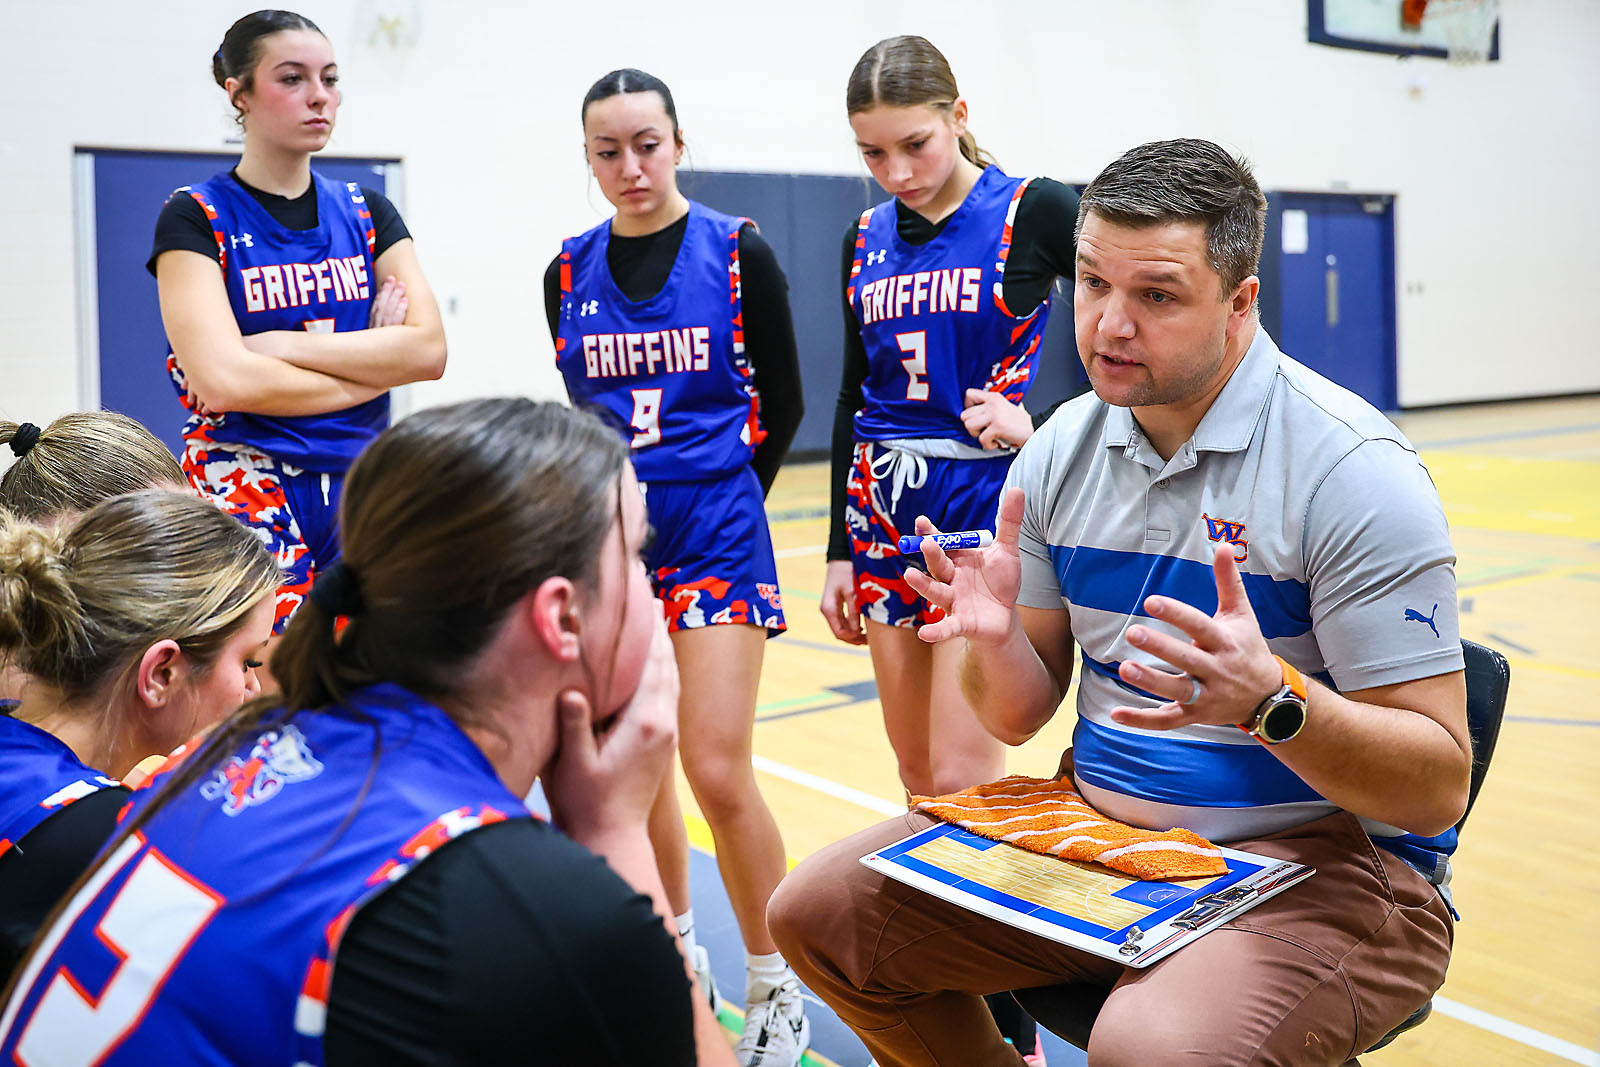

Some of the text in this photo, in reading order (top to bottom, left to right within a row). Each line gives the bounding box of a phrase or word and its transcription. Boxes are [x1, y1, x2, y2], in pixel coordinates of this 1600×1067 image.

[240, 254, 370, 313] GRIFFINS
[861, 267, 983, 325] GRIFFINS
[582, 326, 710, 378] GRIFFINS
[895, 330, 930, 401] 2
[630, 388, 663, 449] 9
[937, 534, 962, 549] EXPO
